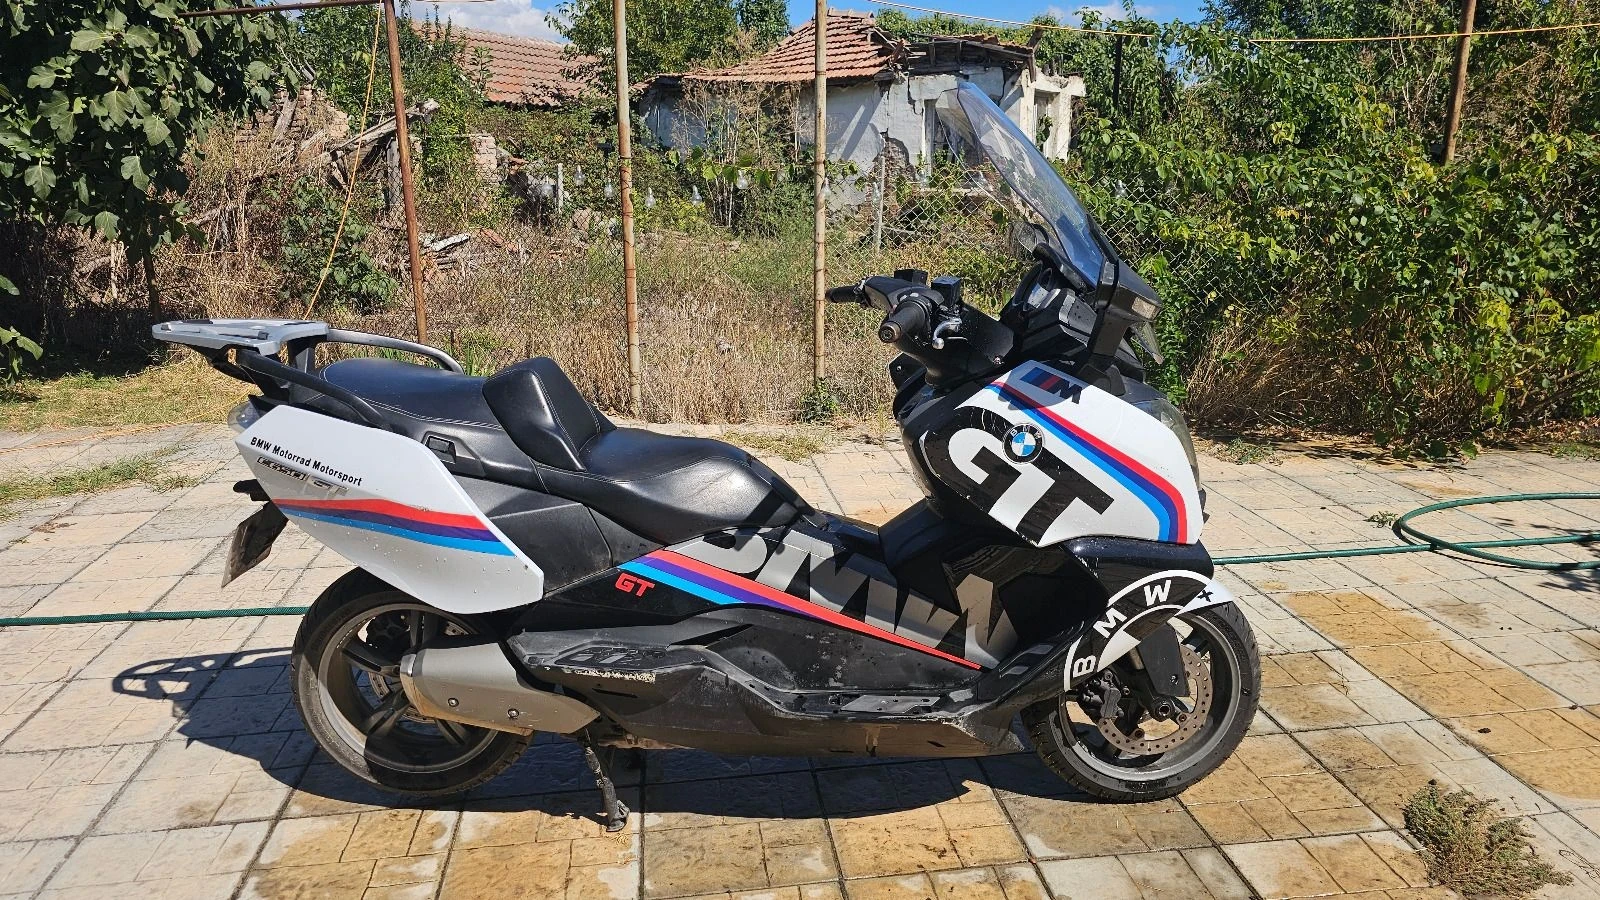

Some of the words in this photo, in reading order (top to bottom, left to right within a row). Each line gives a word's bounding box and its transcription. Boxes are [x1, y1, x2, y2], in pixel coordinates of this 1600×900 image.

[1010, 426, 1042, 440] BMW
[250, 436, 272, 451] BMW
[272, 445, 312, 467] Motorrad
[312, 460, 362, 486] Motorsport
[922, 405, 1115, 545] GT
[615, 572, 656, 597] GT
[1072, 579, 1172, 678] BMW
